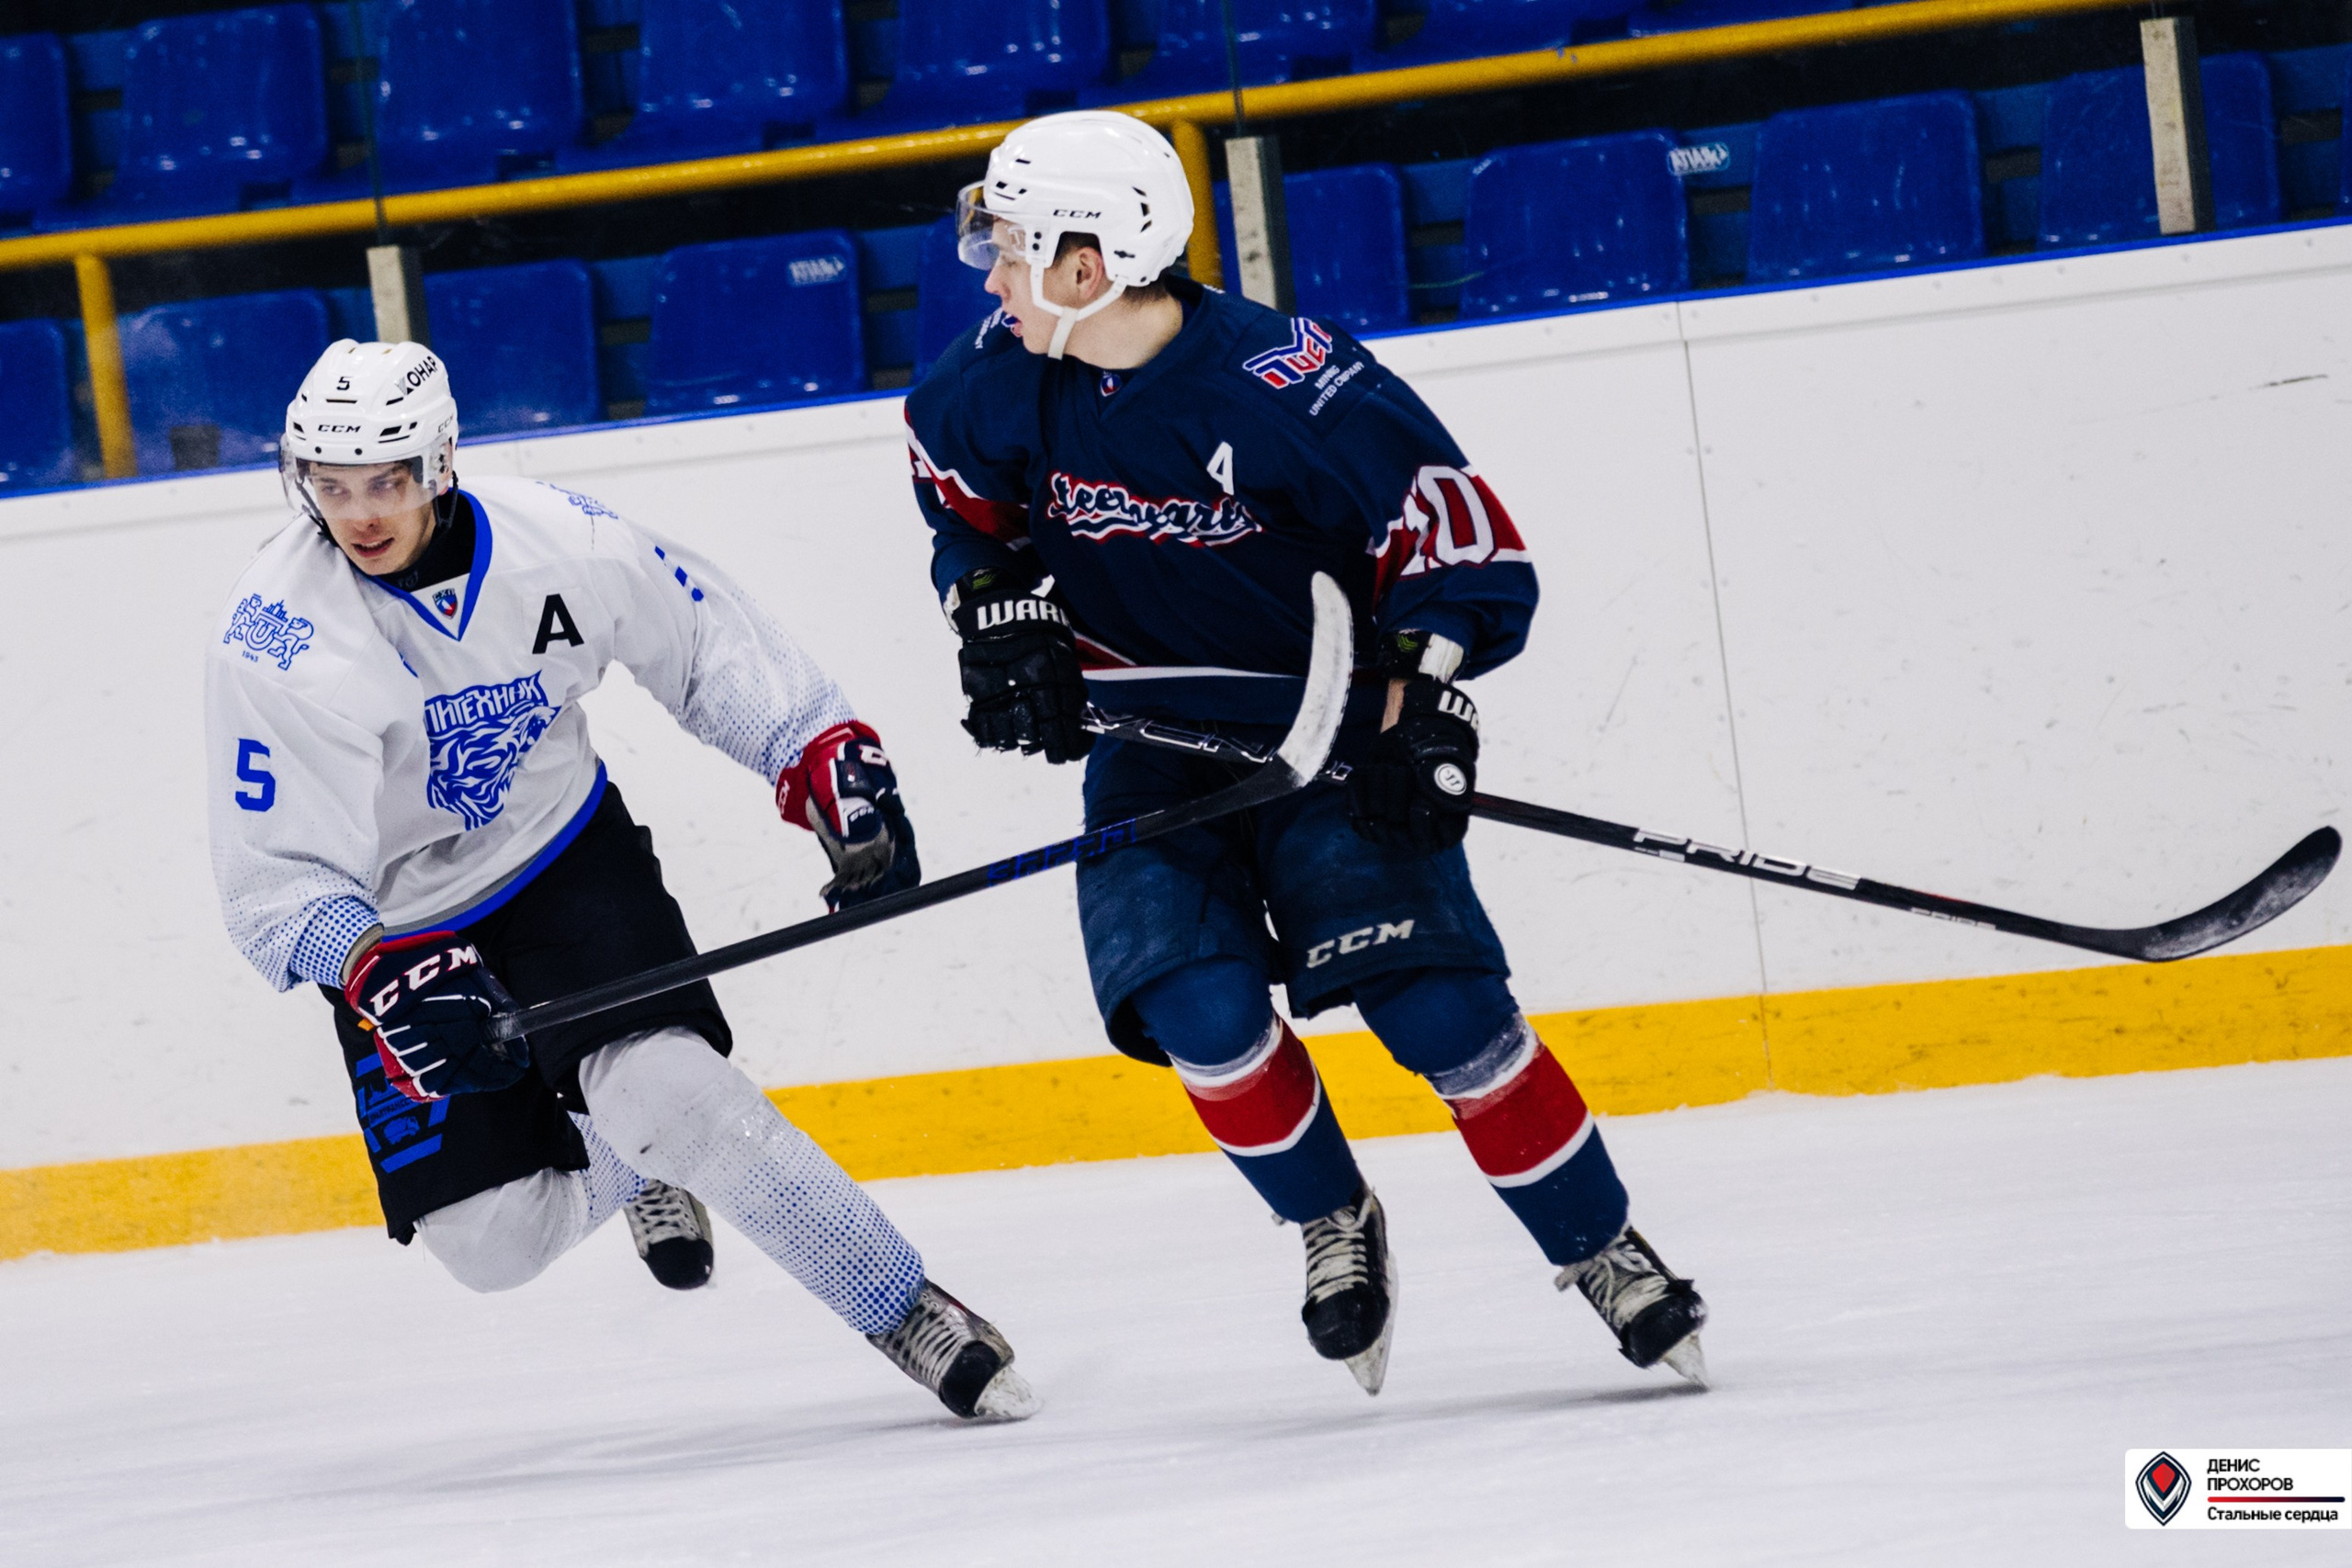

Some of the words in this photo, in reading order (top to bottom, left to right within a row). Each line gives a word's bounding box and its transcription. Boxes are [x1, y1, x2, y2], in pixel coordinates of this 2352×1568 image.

[1053, 209, 1102, 219] CCM
[336, 376, 353, 390] 5
[1309, 385, 1338, 416] UNITED
[318, 423, 361, 433] CCM
[1400, 465, 1495, 576] 10
[532, 593, 584, 655] A
[235, 738, 276, 812] 5
[1634, 828, 1861, 890] PRIDE
[1306, 919, 1415, 968] CCM
[370, 945, 478, 1017] CCM
